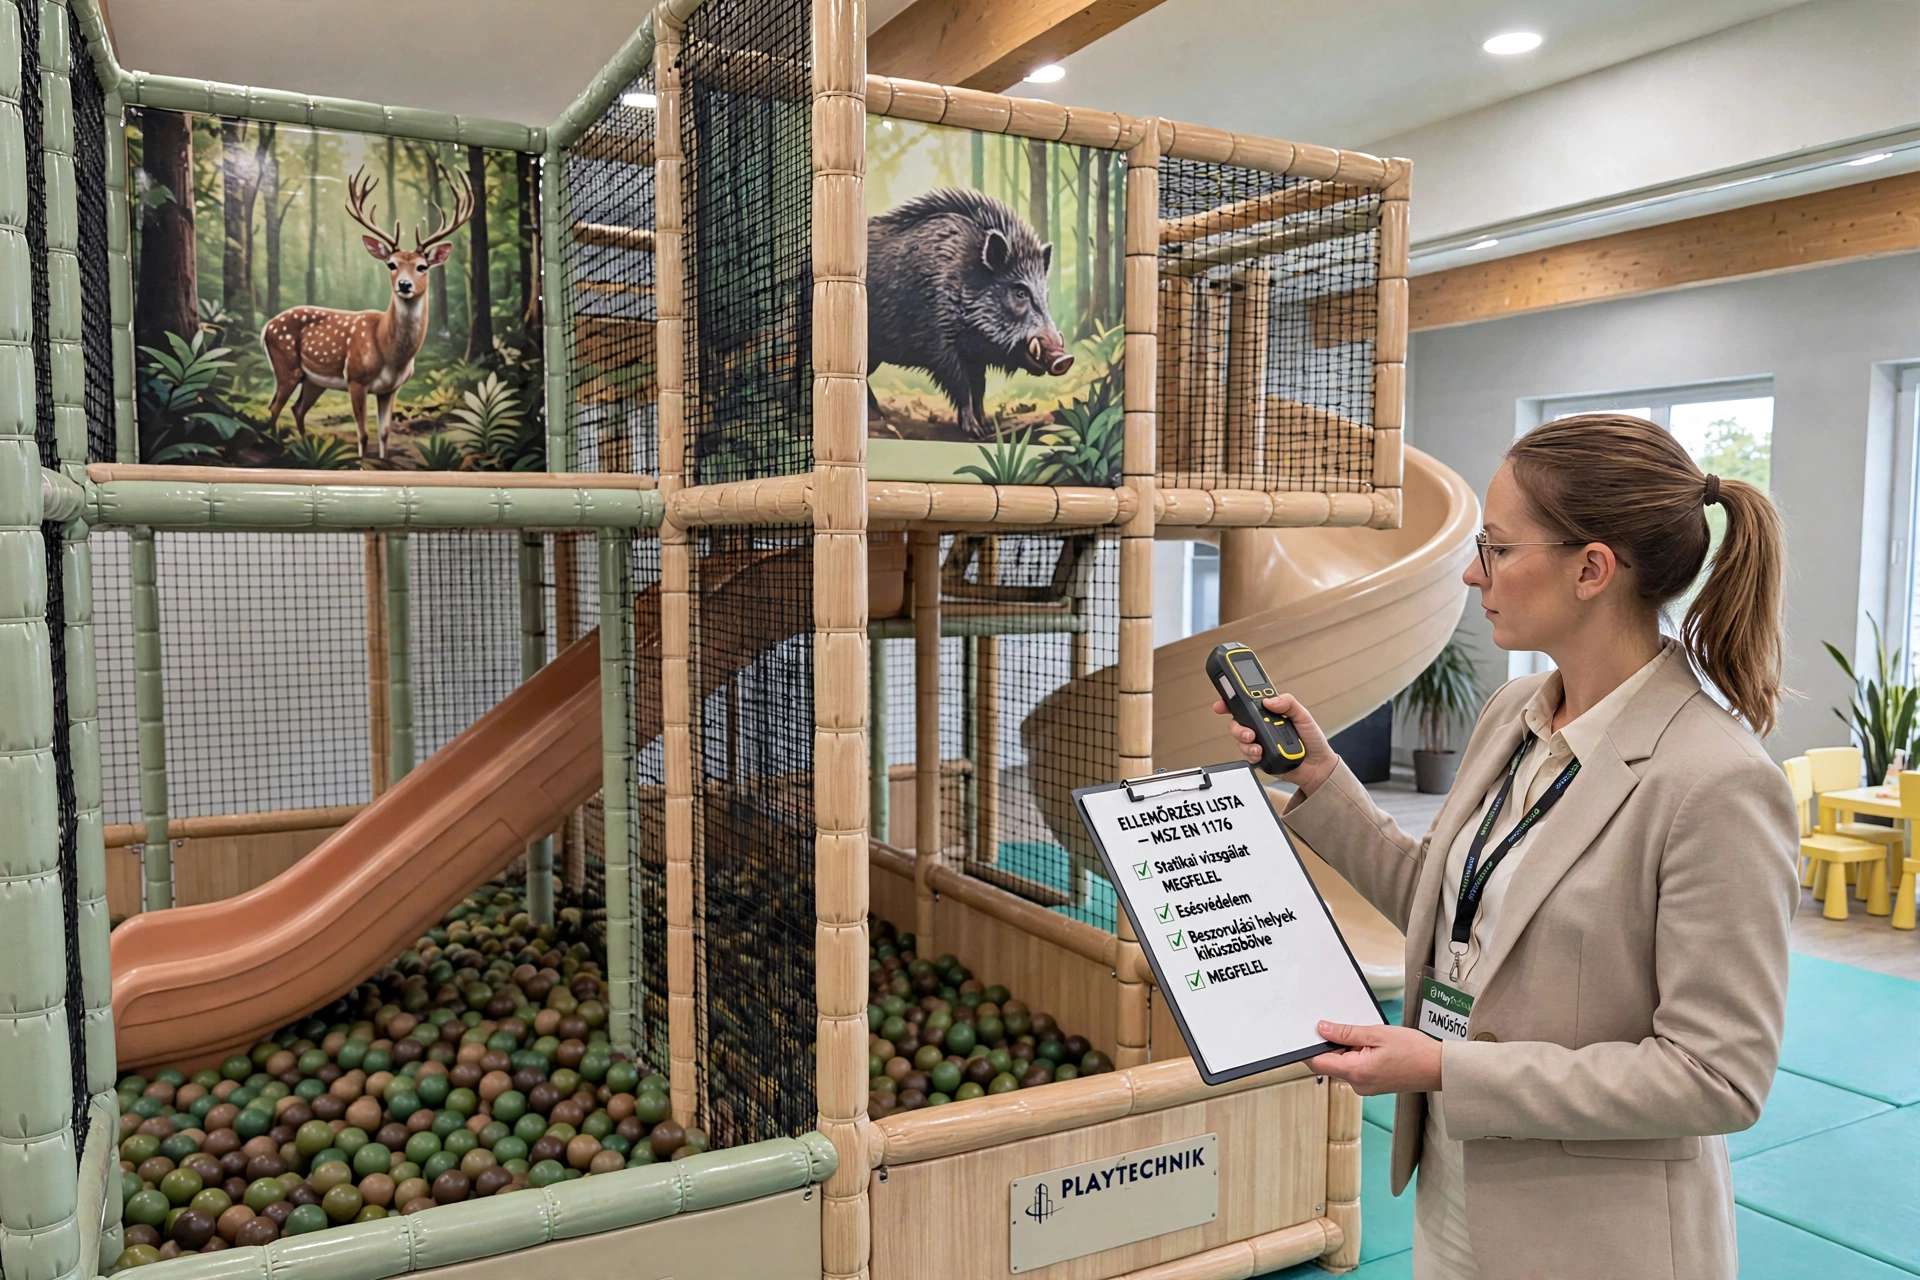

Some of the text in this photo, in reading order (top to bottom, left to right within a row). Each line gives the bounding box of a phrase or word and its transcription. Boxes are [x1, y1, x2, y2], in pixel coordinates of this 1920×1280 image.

[1206, 795, 1245, 813] LISTA
[1150, 827, 1181, 845] MSZ
[1180, 822, 1200, 838] EN
[1202, 817, 1233, 834] 1176
[1154, 844, 1251, 874] Statikai vizsgálat
[1162, 870, 1222, 893] MEGFELEL
[1175, 893, 1252, 918] Esésvédelem
[1187, 907, 1297, 944] Beszorulási helyek
[1206, 959, 1268, 984] MEGFELEL
[1428, 1009, 1467, 1038] TANÚSÍTÓ
[1061, 1147, 1206, 1199] PLAYTECHNIK
